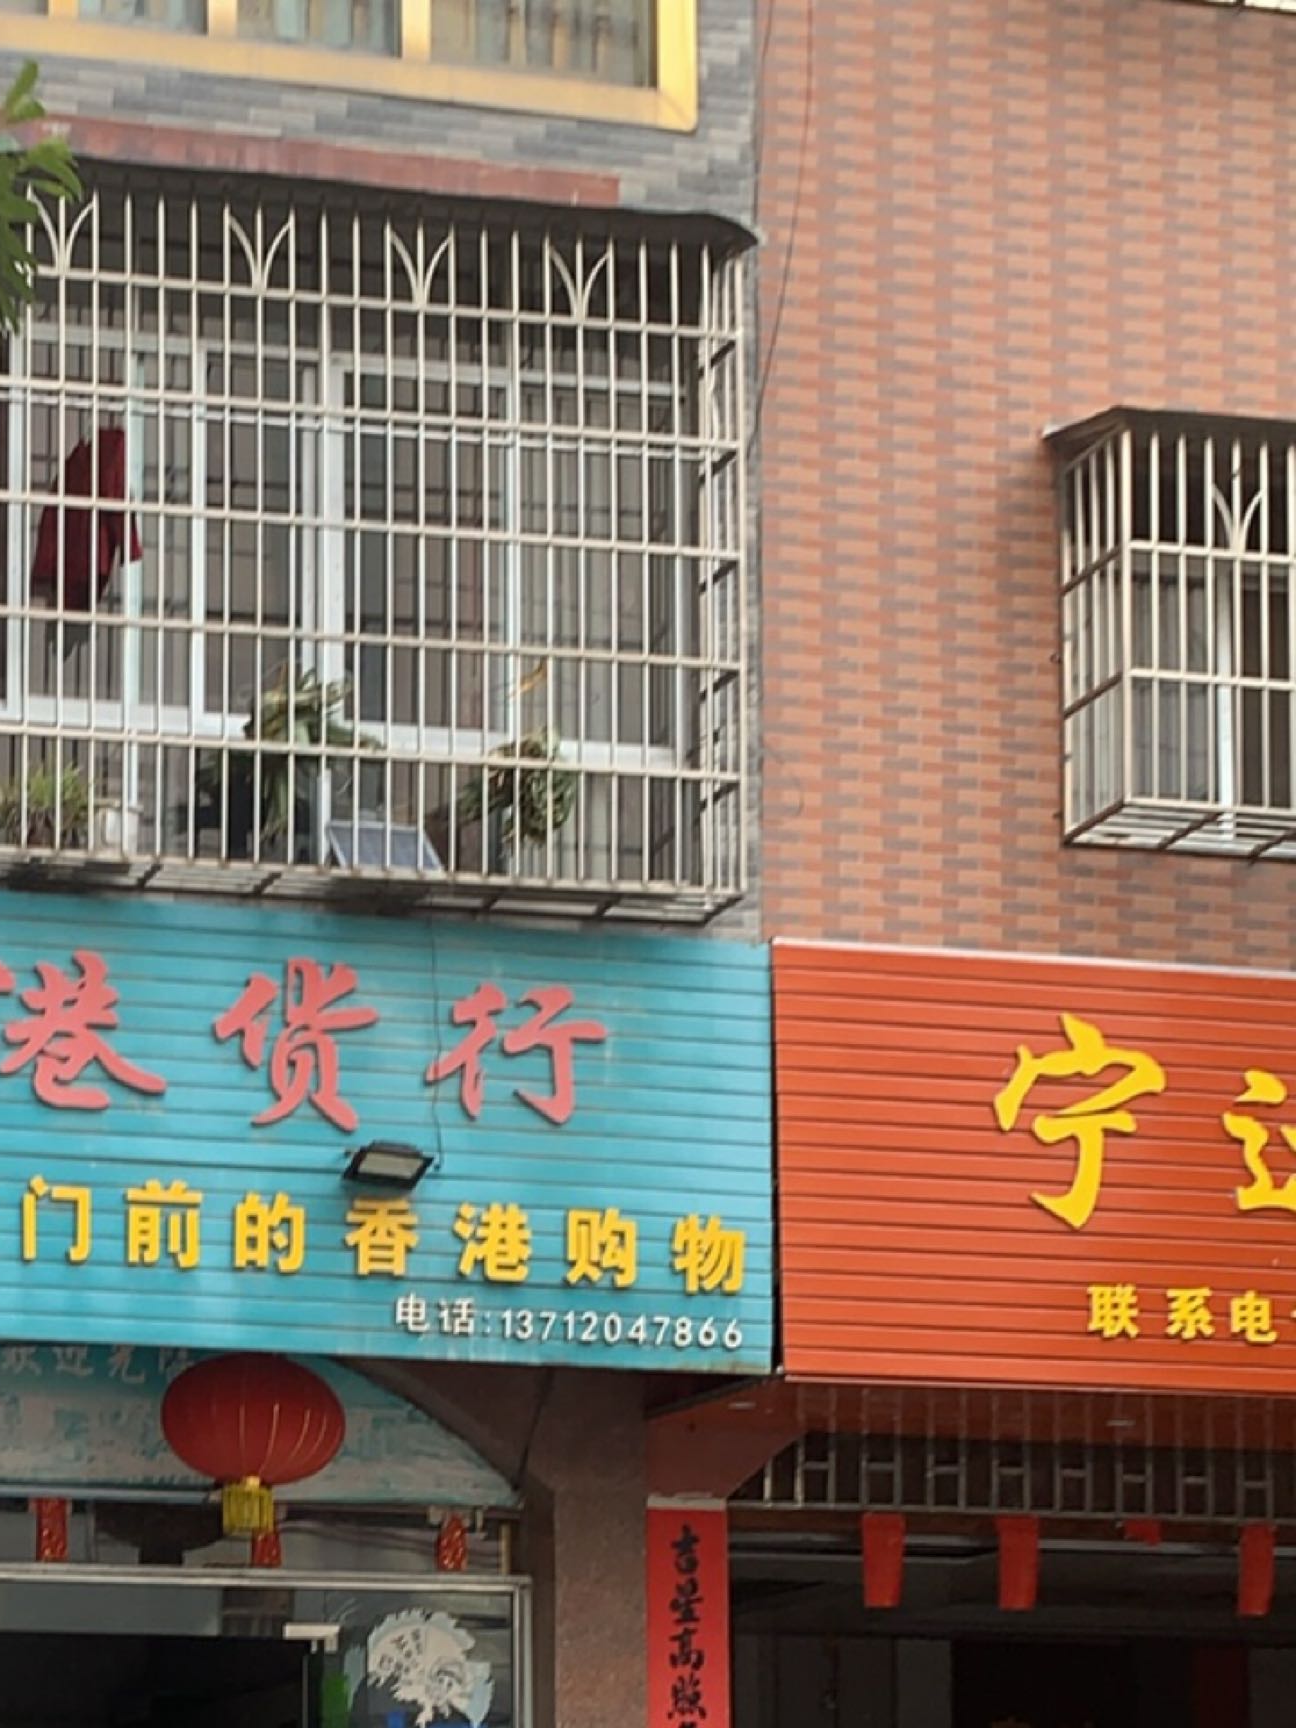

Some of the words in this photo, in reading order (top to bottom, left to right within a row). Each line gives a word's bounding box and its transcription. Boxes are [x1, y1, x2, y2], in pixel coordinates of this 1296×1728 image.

[394, 1291, 744, 1350] 电话:13712047866
[1086, 1282, 1296, 1345] 联系电
